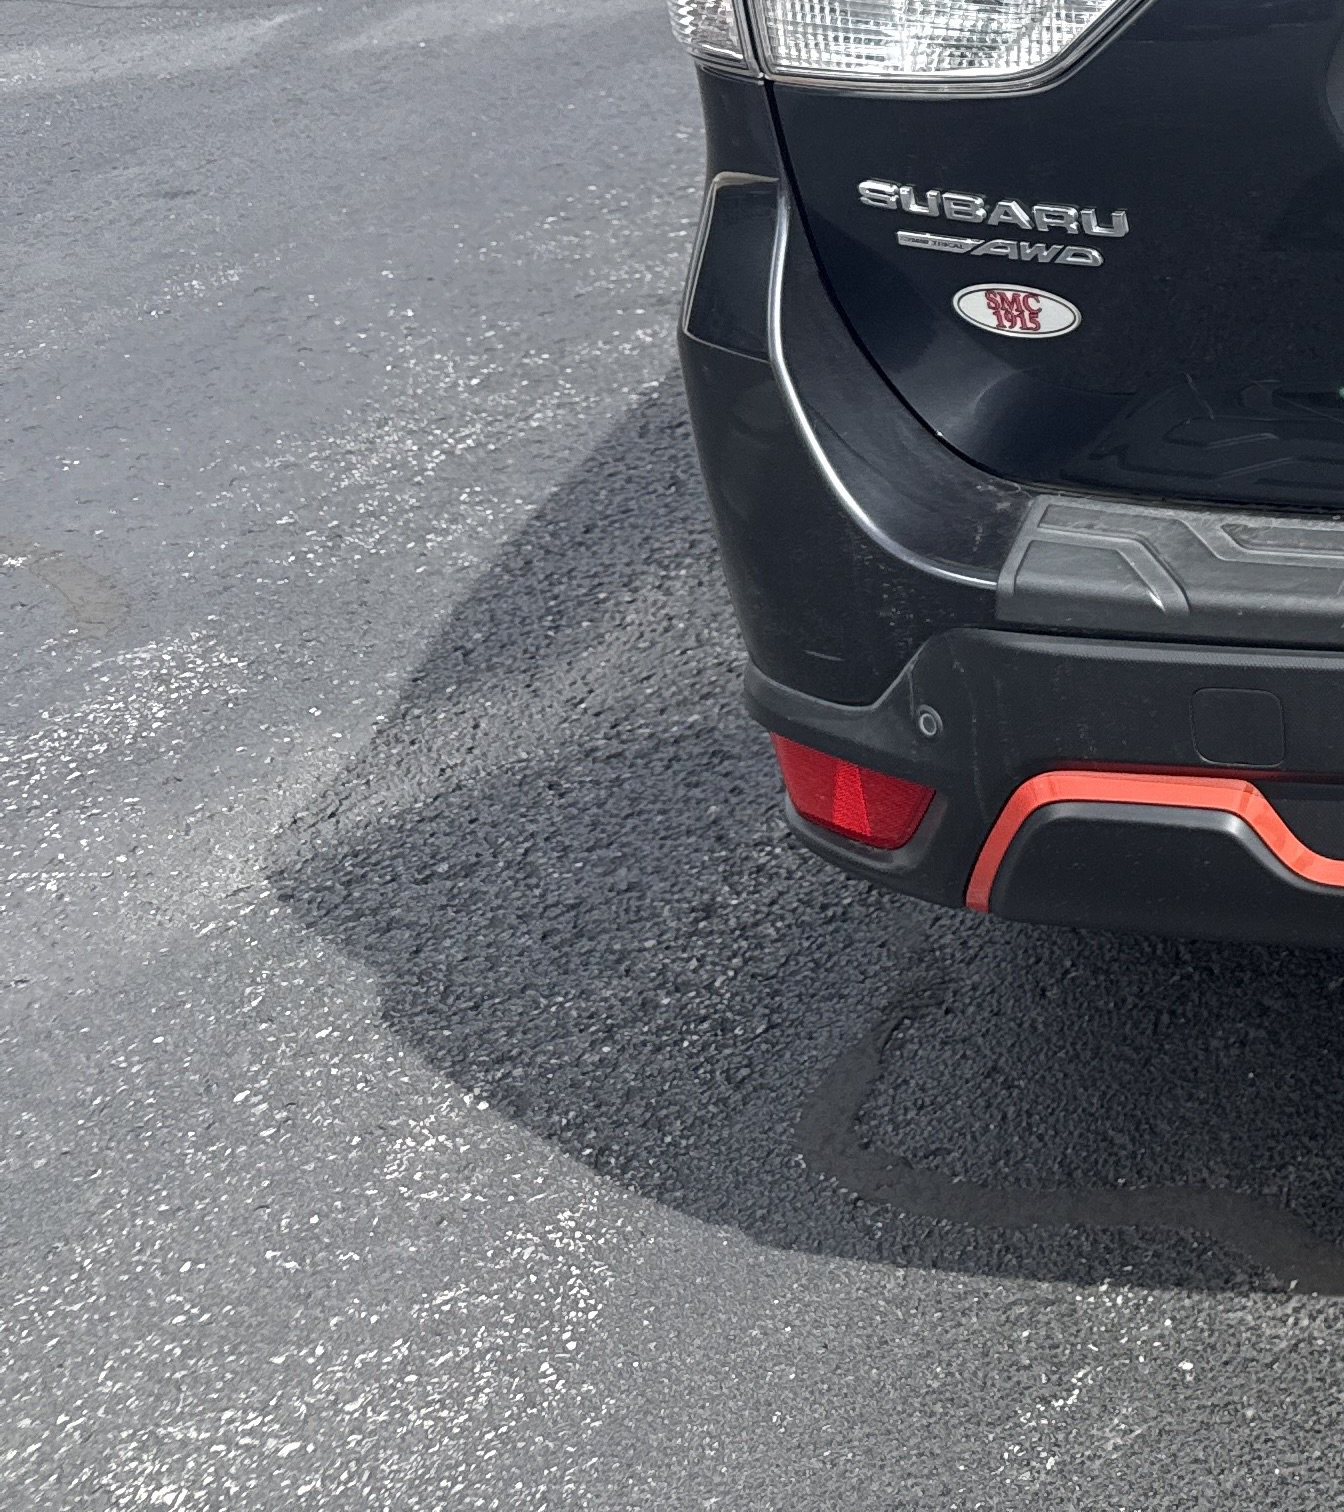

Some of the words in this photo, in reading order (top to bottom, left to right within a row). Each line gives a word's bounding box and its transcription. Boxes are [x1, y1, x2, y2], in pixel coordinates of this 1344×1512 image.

[857, 178, 1130, 238] SUBARU
[970, 239, 1105, 267] AWD
[984, 289, 1043, 315] SMC
[992, 310, 1042, 332] 1915
